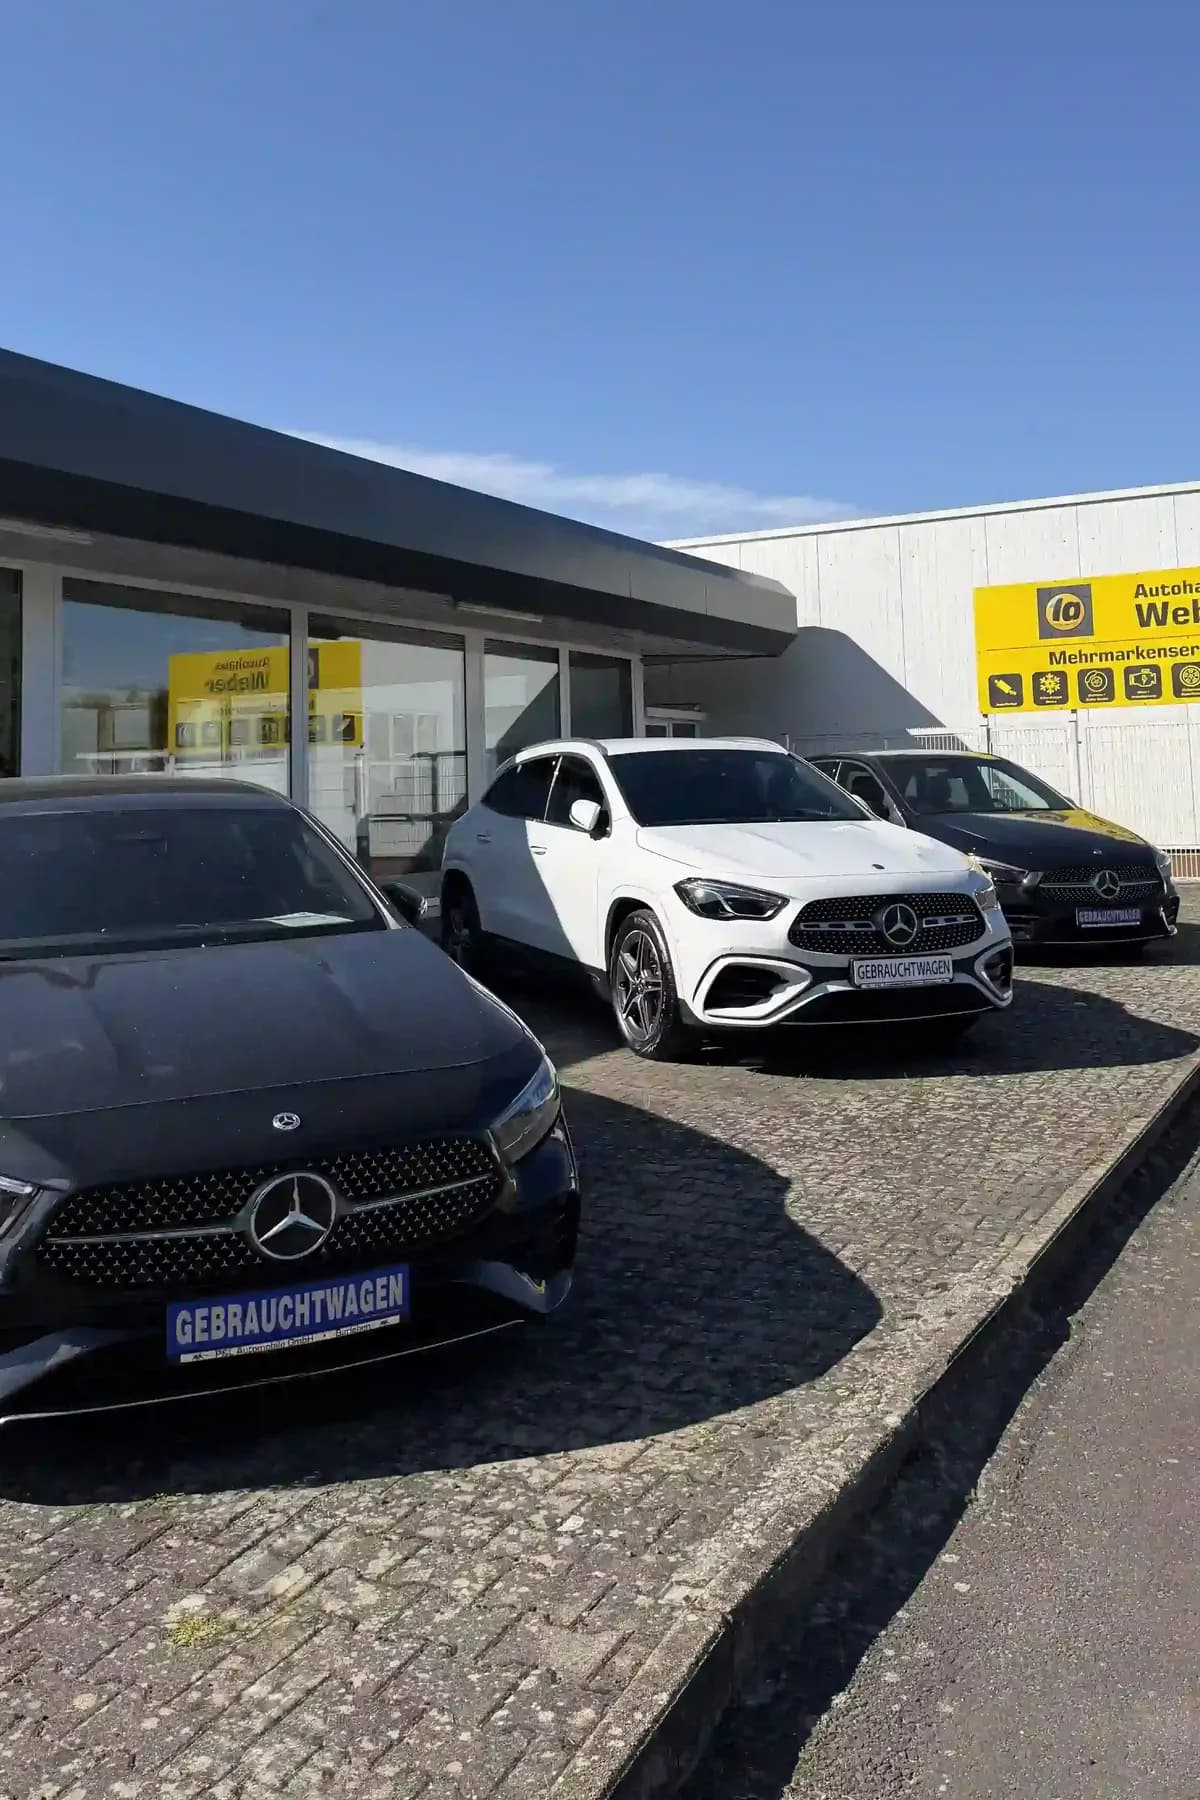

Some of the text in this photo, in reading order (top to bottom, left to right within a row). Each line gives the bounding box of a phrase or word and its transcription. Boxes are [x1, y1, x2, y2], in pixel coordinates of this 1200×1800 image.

[1049, 644, 1200, 665] Mehrmarkenser
[1079, 908, 1141, 922] GEBRAUCHTWAGEN
[857, 960, 951, 979] GEBRAUCHTWAGEN
[175, 1273, 404, 1345] GEBRAUCHTWAGEN
